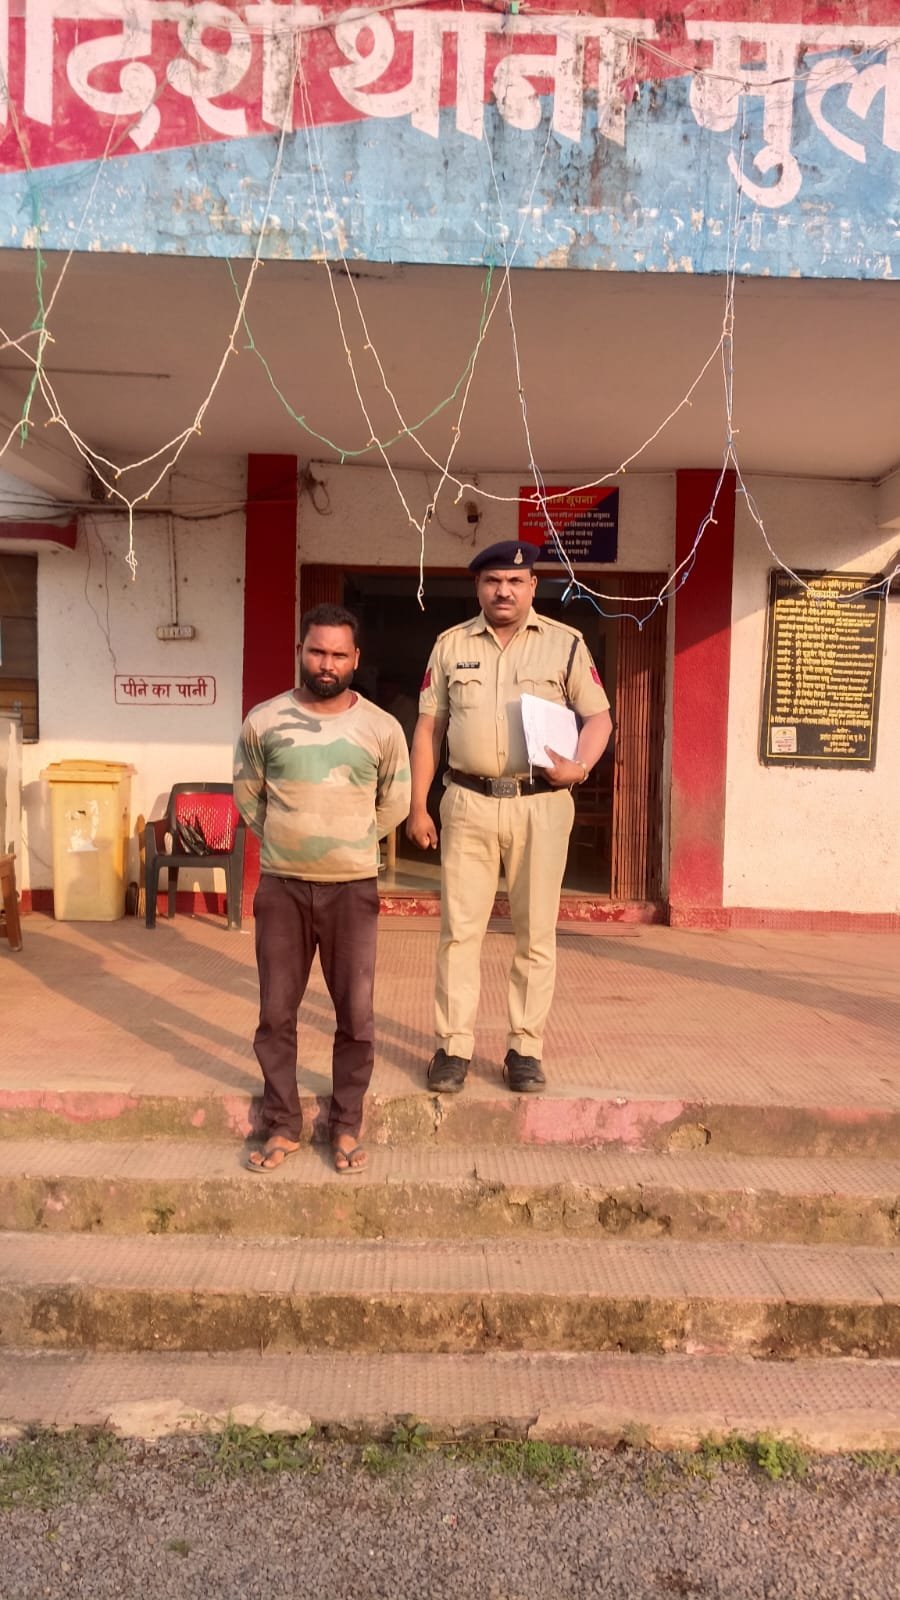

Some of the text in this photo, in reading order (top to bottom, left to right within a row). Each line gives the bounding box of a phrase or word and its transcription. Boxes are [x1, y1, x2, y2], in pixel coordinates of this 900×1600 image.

[329, 5, 657, 147] थाना
[121, 677, 207, 698] पीने का पानी
